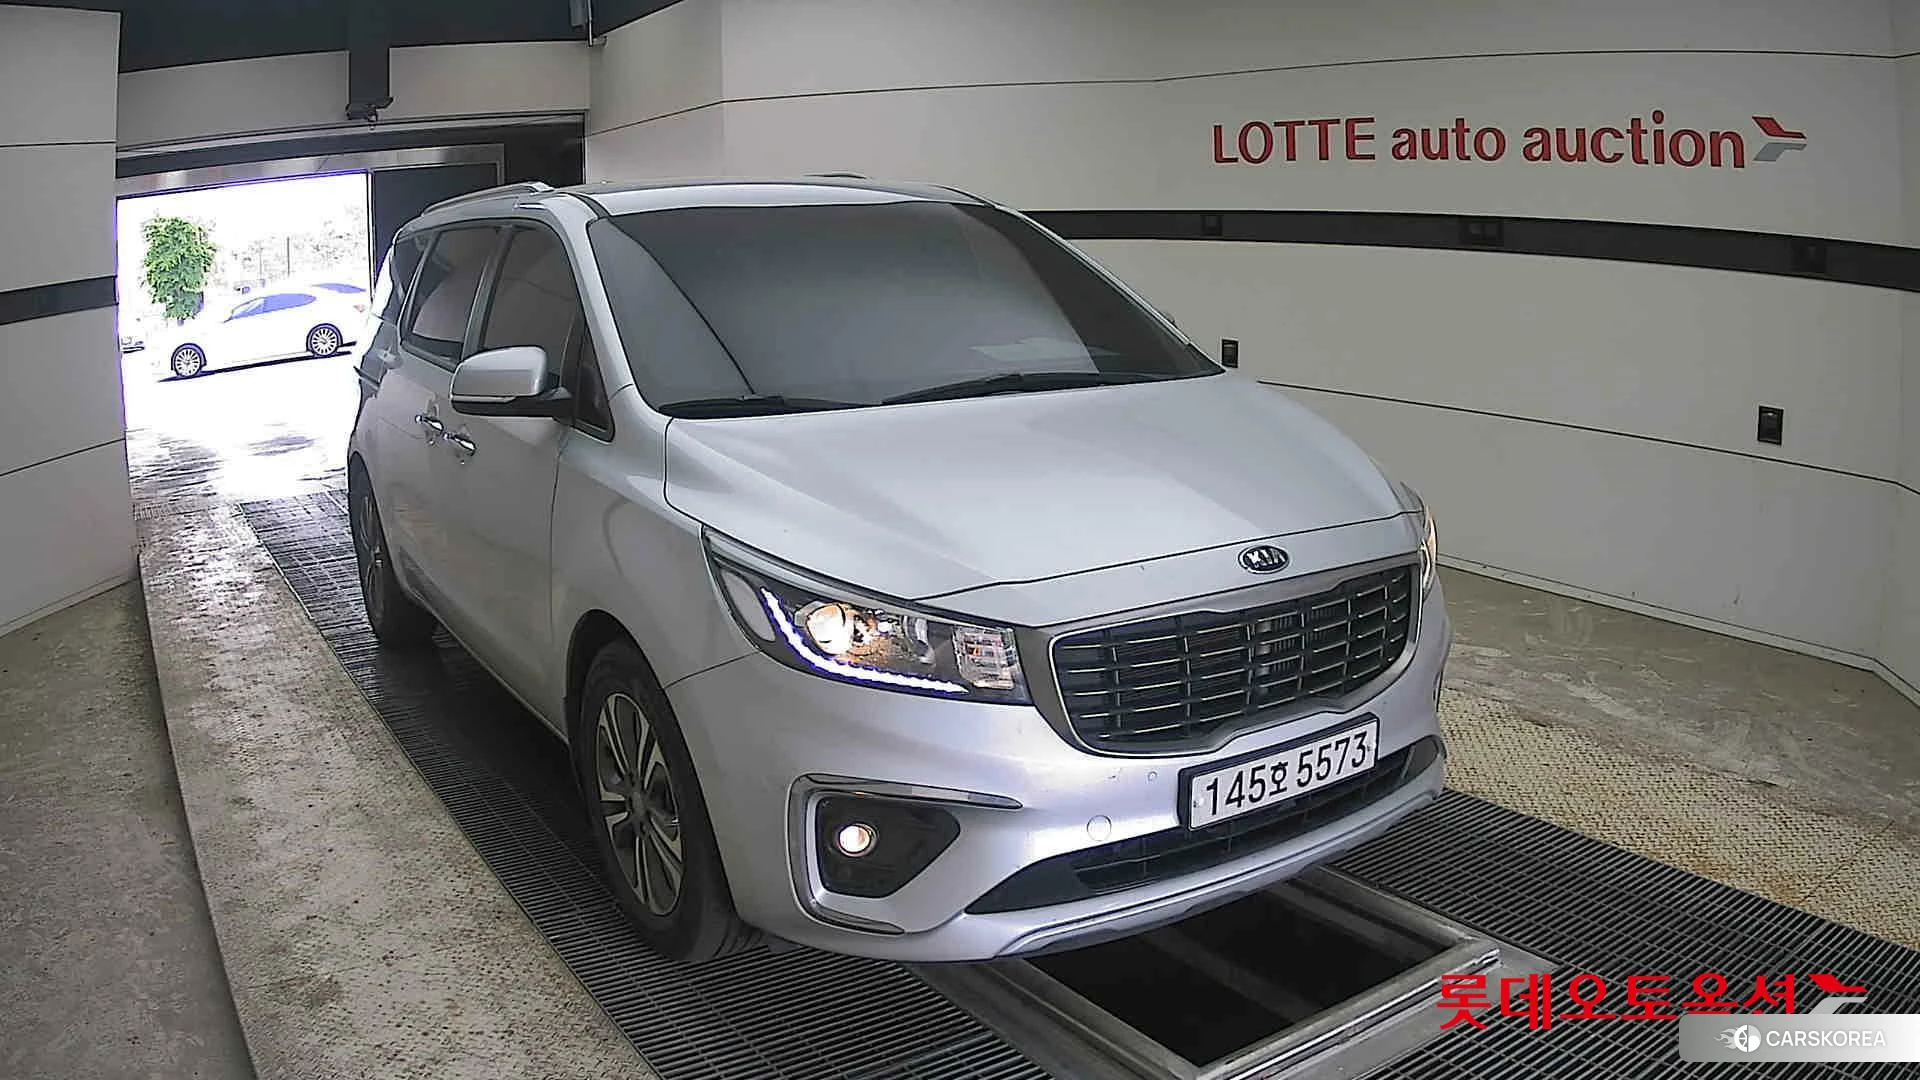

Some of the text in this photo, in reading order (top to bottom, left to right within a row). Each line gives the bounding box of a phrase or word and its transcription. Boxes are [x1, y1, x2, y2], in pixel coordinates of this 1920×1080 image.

[1212, 109, 1746, 169] LOTTE auto auction
[1245, 549, 1286, 568] KIA
[1206, 730, 1369, 816] 145호 5573
